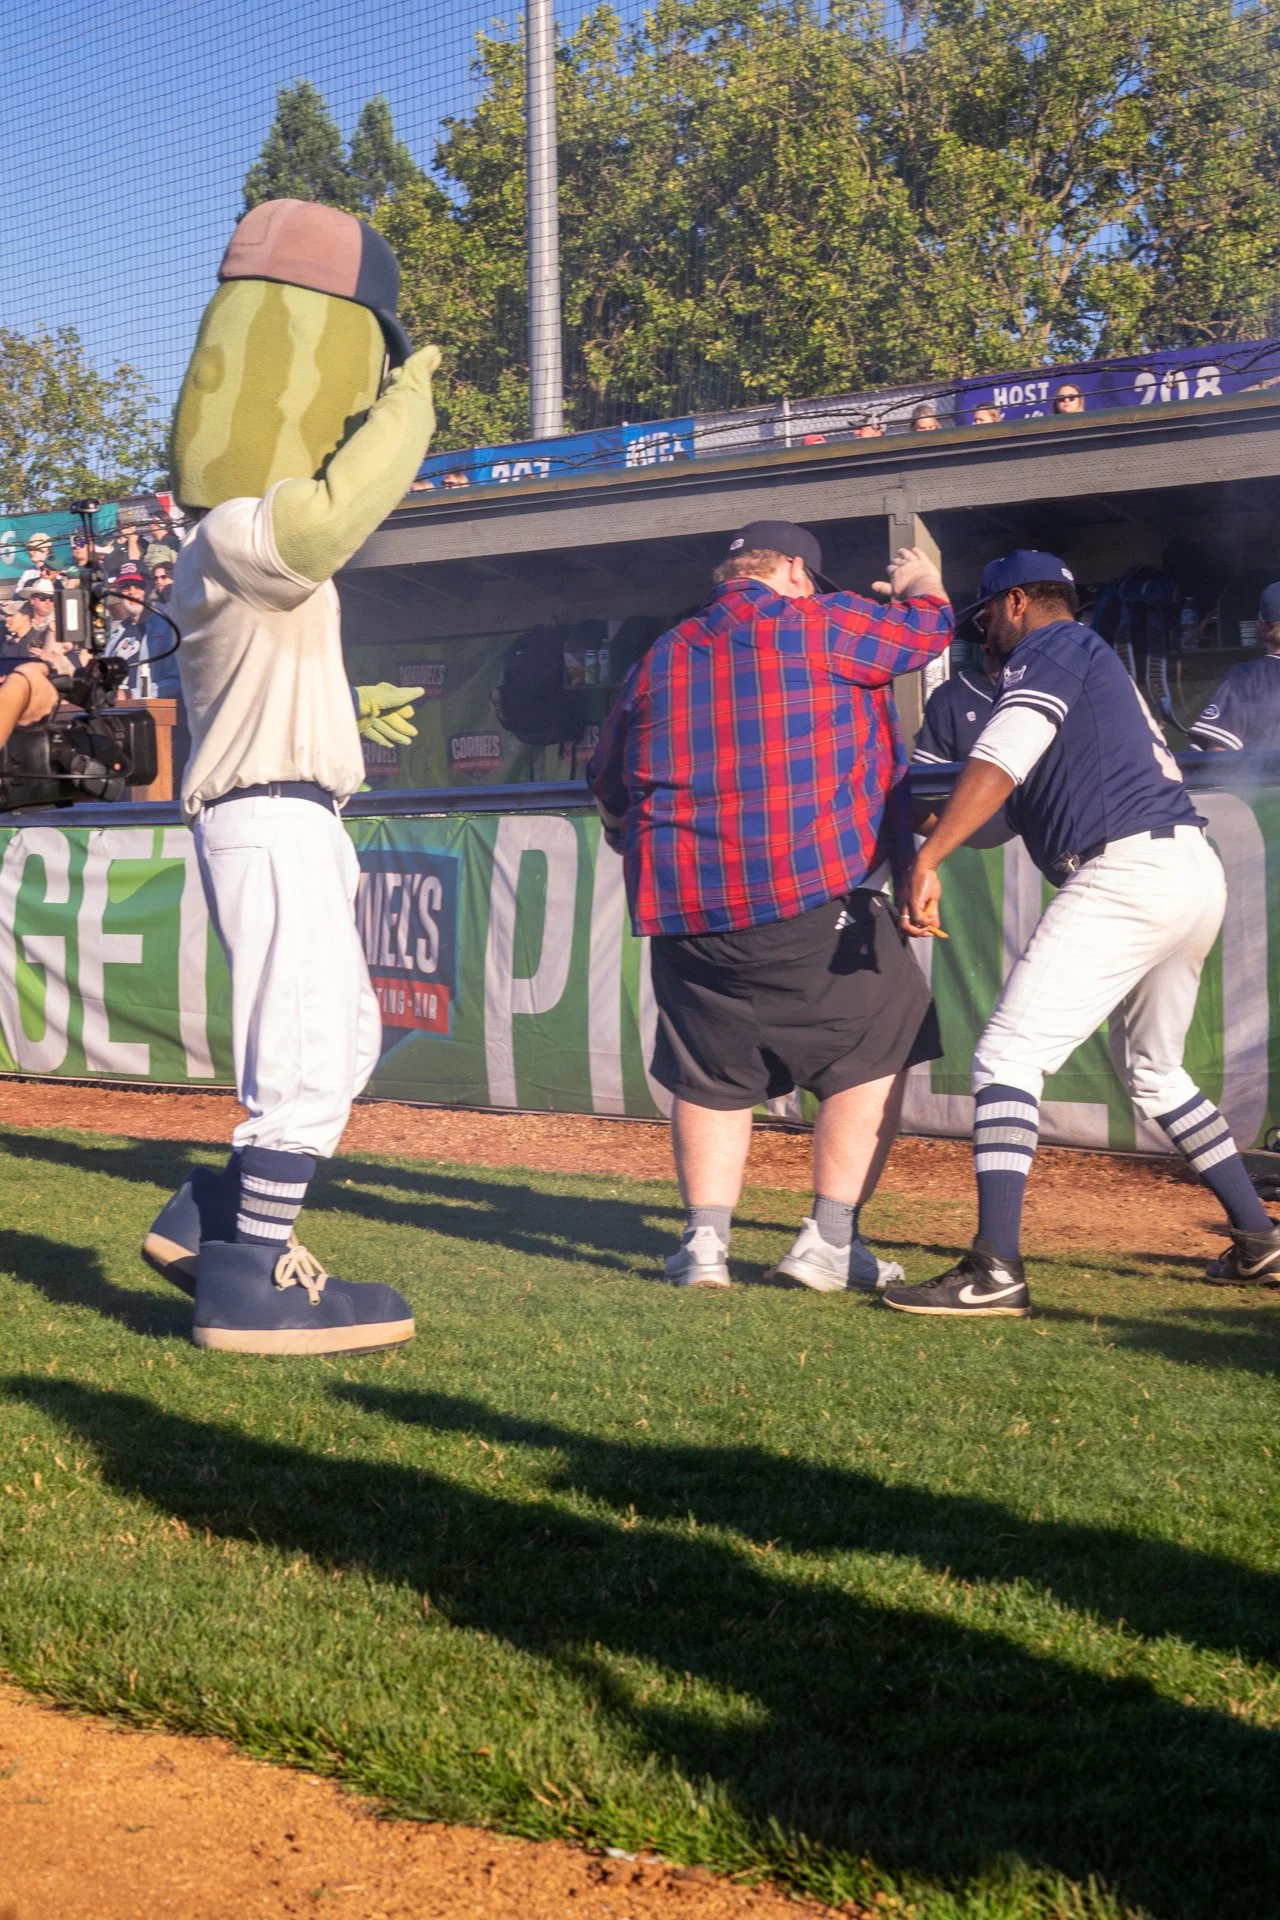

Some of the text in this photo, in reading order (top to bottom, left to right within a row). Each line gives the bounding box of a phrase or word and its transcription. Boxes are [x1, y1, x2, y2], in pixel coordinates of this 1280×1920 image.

[993, 381, 1050, 408] HOST
[1134, 366, 1223, 405] 208
[0, 826, 216, 1078] GET
[355, 872, 443, 974] NEL'S
